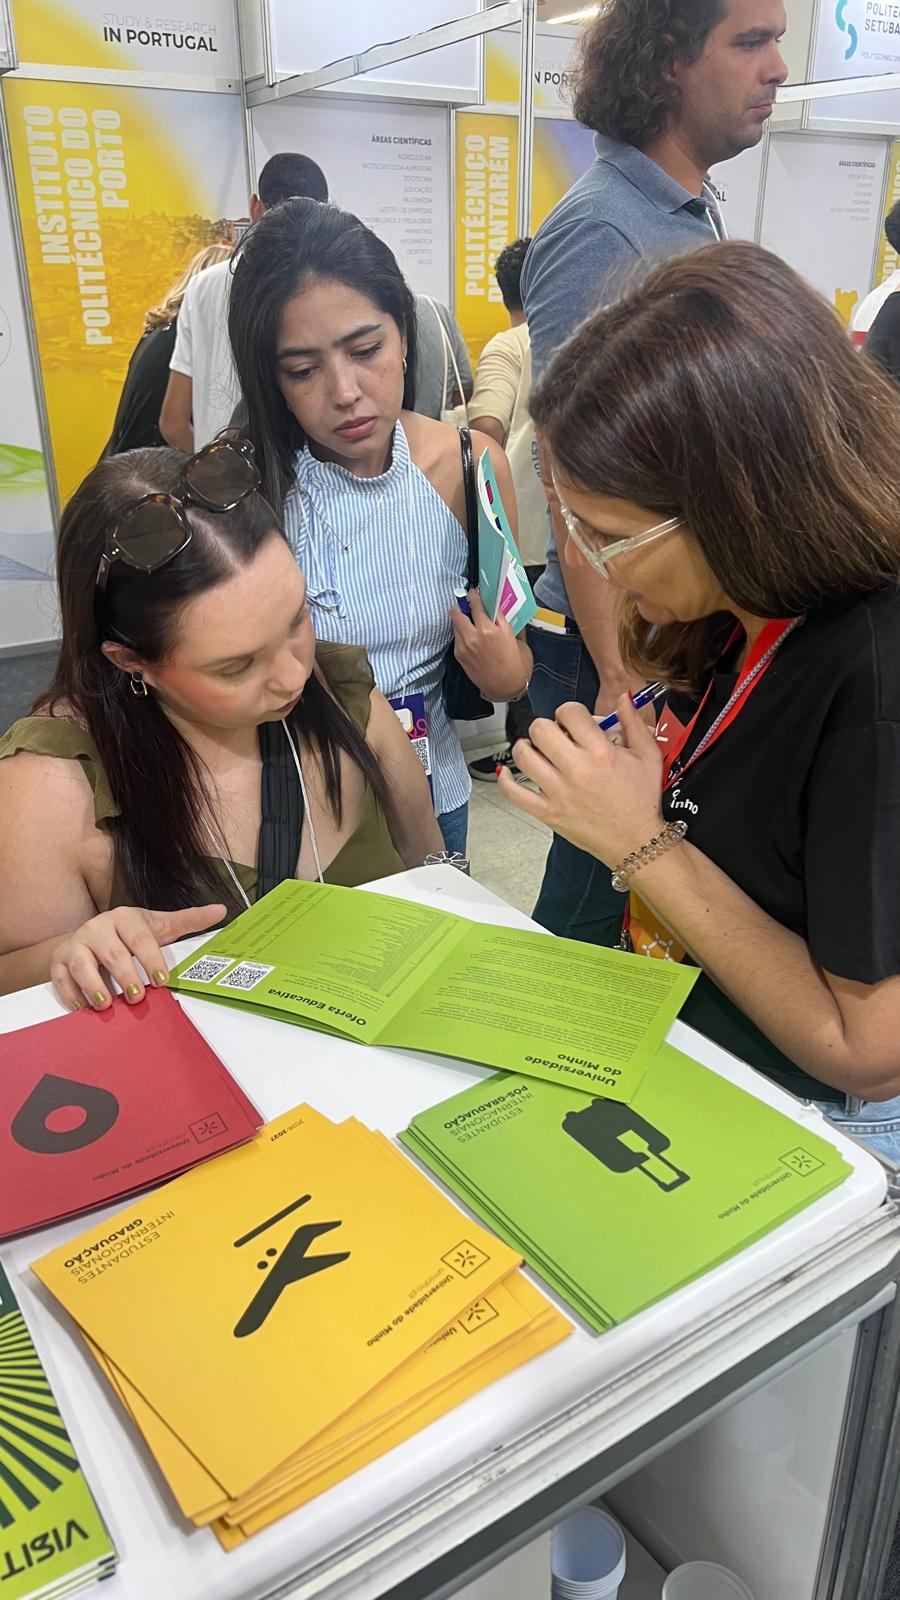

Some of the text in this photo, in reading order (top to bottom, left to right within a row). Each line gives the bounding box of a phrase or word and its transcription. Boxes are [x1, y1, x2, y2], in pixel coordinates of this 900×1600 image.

[103, 13, 216, 34] STUDY & RESEARCH
[867, 2, 900, 18] POLITE
[104, 26, 218, 52] IN PORTUGAL
[92, 109, 129, 208] PORTO
[372, 134, 432, 146] ÁREAS CIENTÍFICAS
[23, 105, 71, 264] INSTITUTO
[58, 107, 112, 345] POLITÉCNICO DO
[461, 134, 486, 296] POLITÉCNICO
[670, 797, 698, 814] inho
[268, 989, 326, 1009] Educativa
[328, 1006, 366, 1025] Oferta
[525, 1056, 616, 1086] Universidade
[557, 1054, 622, 1076] do Minho
[444, 1085, 528, 1129] PÓS-GRADUAÇÃO
[450, 1092, 534, 1136] INTERNACIONAIS
[457, 1107, 523, 1143] ESTUDANTES
[64, 1219, 143, 1268] GRADUAÇÃO
[70, 1210, 175, 1276] INTERNACIONAIS
[78, 1232, 160, 1284] ESTUDANTES
[367, 1274, 453, 1346] Universidade do Minho
[2, 1520, 89, 1580] VISIT
